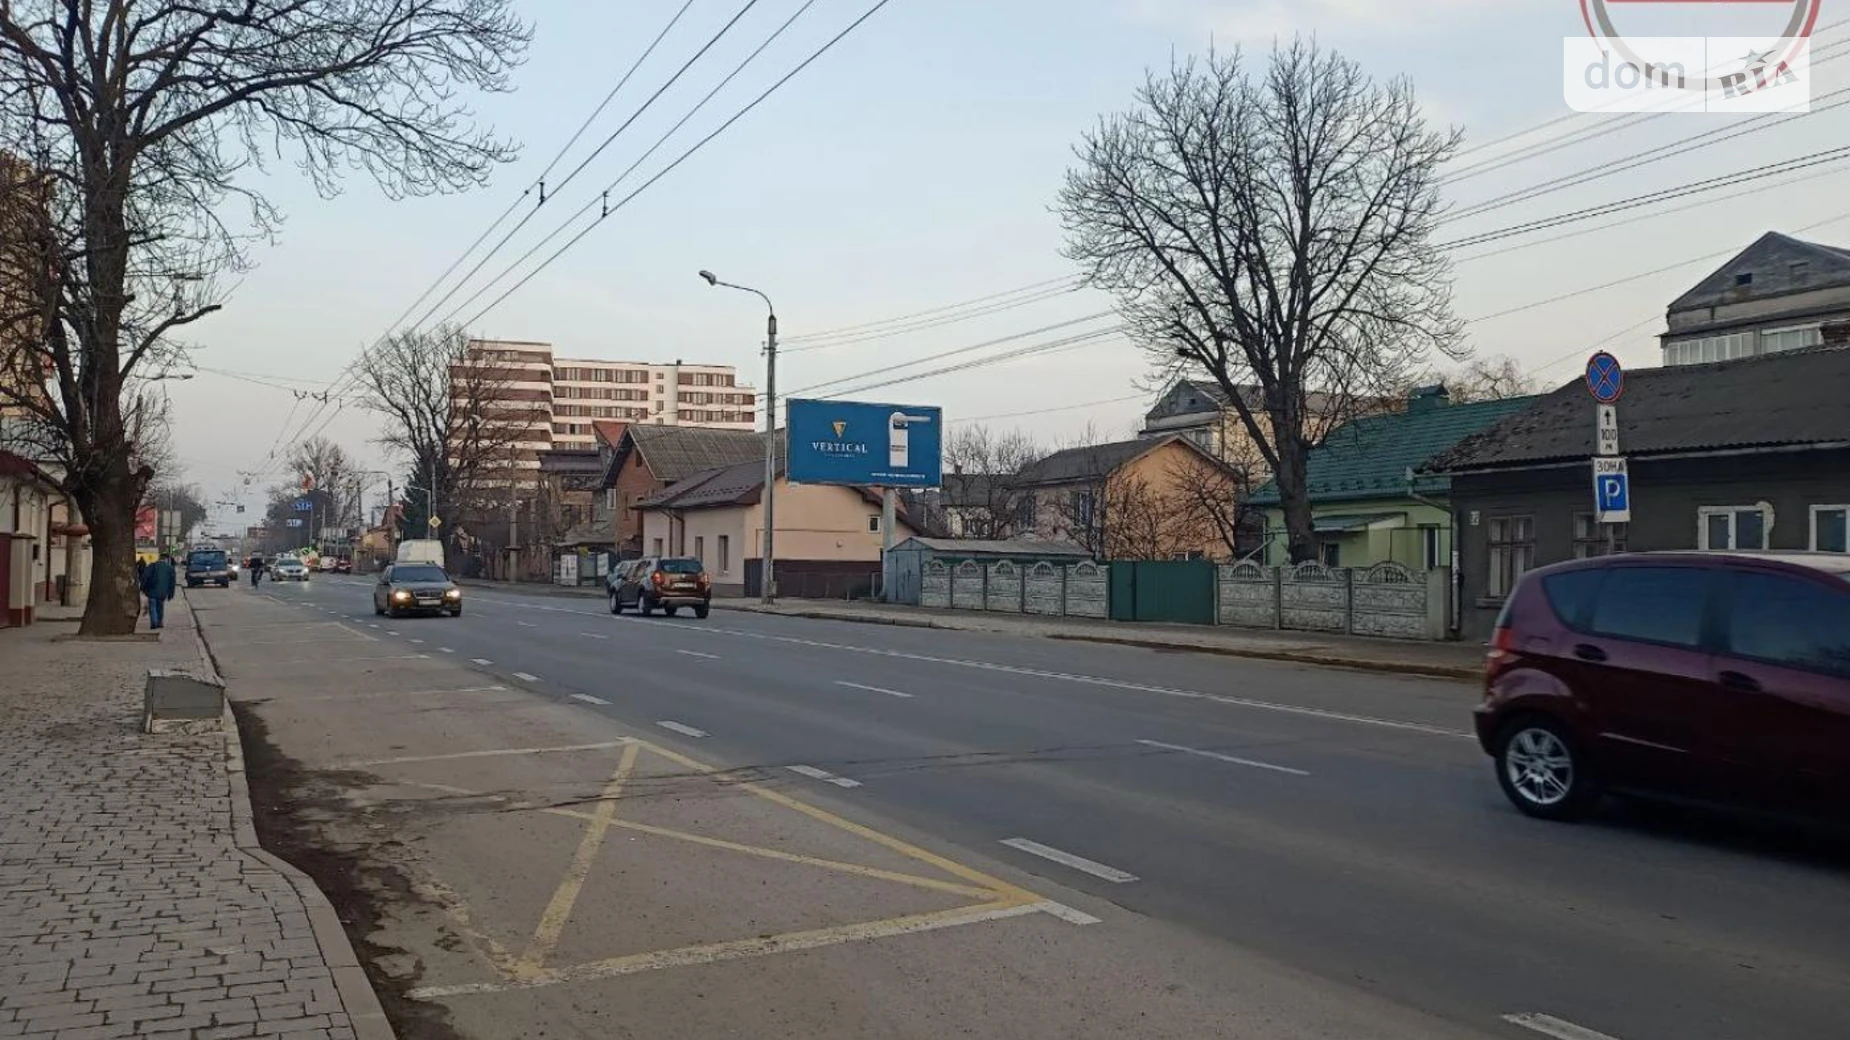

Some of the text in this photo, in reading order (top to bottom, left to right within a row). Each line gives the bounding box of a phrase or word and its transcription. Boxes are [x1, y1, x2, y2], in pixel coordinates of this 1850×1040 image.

[1601, 428, 1617, 440] 100
[812, 441, 868, 454] VERTICAL
[1596, 460, 1625, 473] ЗОНА
[1605, 479, 1621, 507] P
